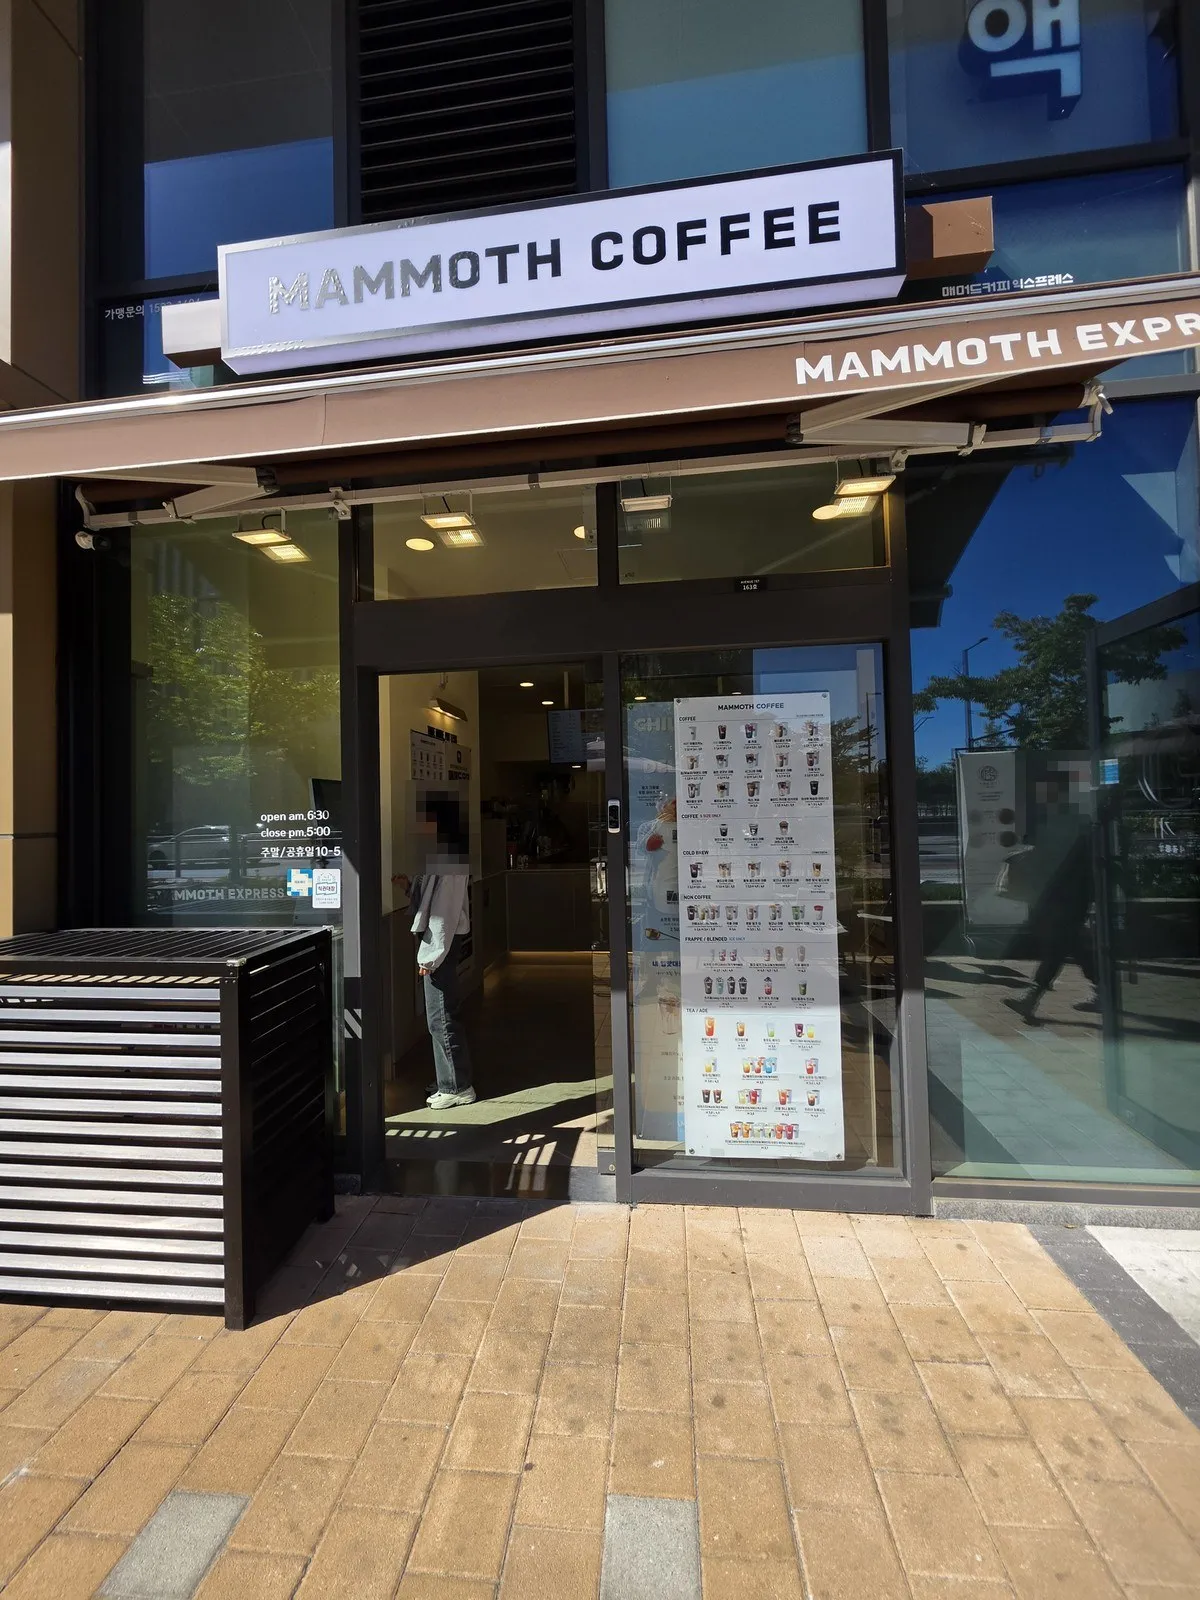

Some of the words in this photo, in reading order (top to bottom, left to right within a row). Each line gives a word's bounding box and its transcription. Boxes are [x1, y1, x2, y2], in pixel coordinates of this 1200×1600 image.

[268, 238, 562, 314] MAMMOTH
[591, 200, 841, 271] COFFEE
[941, 280, 1010, 297] 매머드커피
[1012, 273, 1074, 290] 익스프레스
[104, 305, 145, 320] 가맹문의
[795, 325, 1063, 386] MAMMOTH
[1076, 312, 1200, 353] EXPR
[717, 703, 755, 711] MAMMOTH
[756, 702, 785, 710] COFFEE
[260, 813, 287, 823] open
[260, 828, 287, 838] close
[228, 888, 286, 900] EXPRESS
